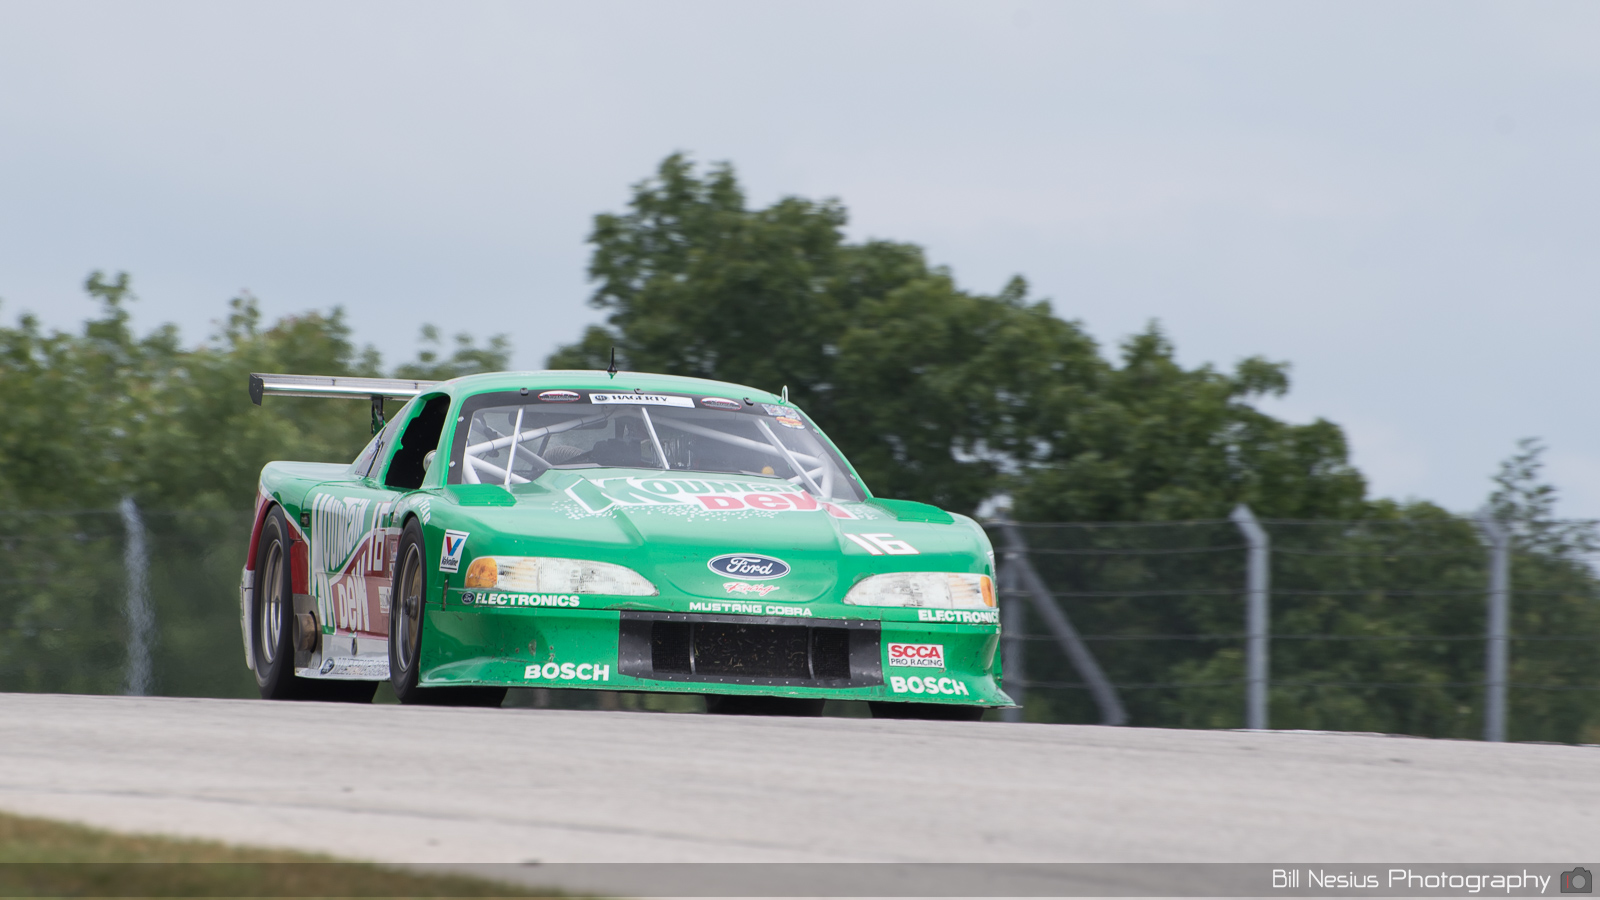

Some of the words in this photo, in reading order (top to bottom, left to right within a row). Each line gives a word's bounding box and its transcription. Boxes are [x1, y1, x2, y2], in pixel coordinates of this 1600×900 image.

[843, 533, 921, 555] 16
[441, 556, 459, 567] Valvoline
[726, 557, 773, 575] Ford
[723, 582, 780, 596] Racing
[475, 593, 580, 607] ELECTRONICS
[689, 602, 762, 614] MUSTANG
[766, 605, 812, 616] COBRA
[890, 644, 941, 659] SCCA
[890, 658, 909, 666] PRO
[910, 659, 943, 667] RACING
[524, 662, 610, 681] BOSCH
[890, 676, 969, 696] BOSCH
